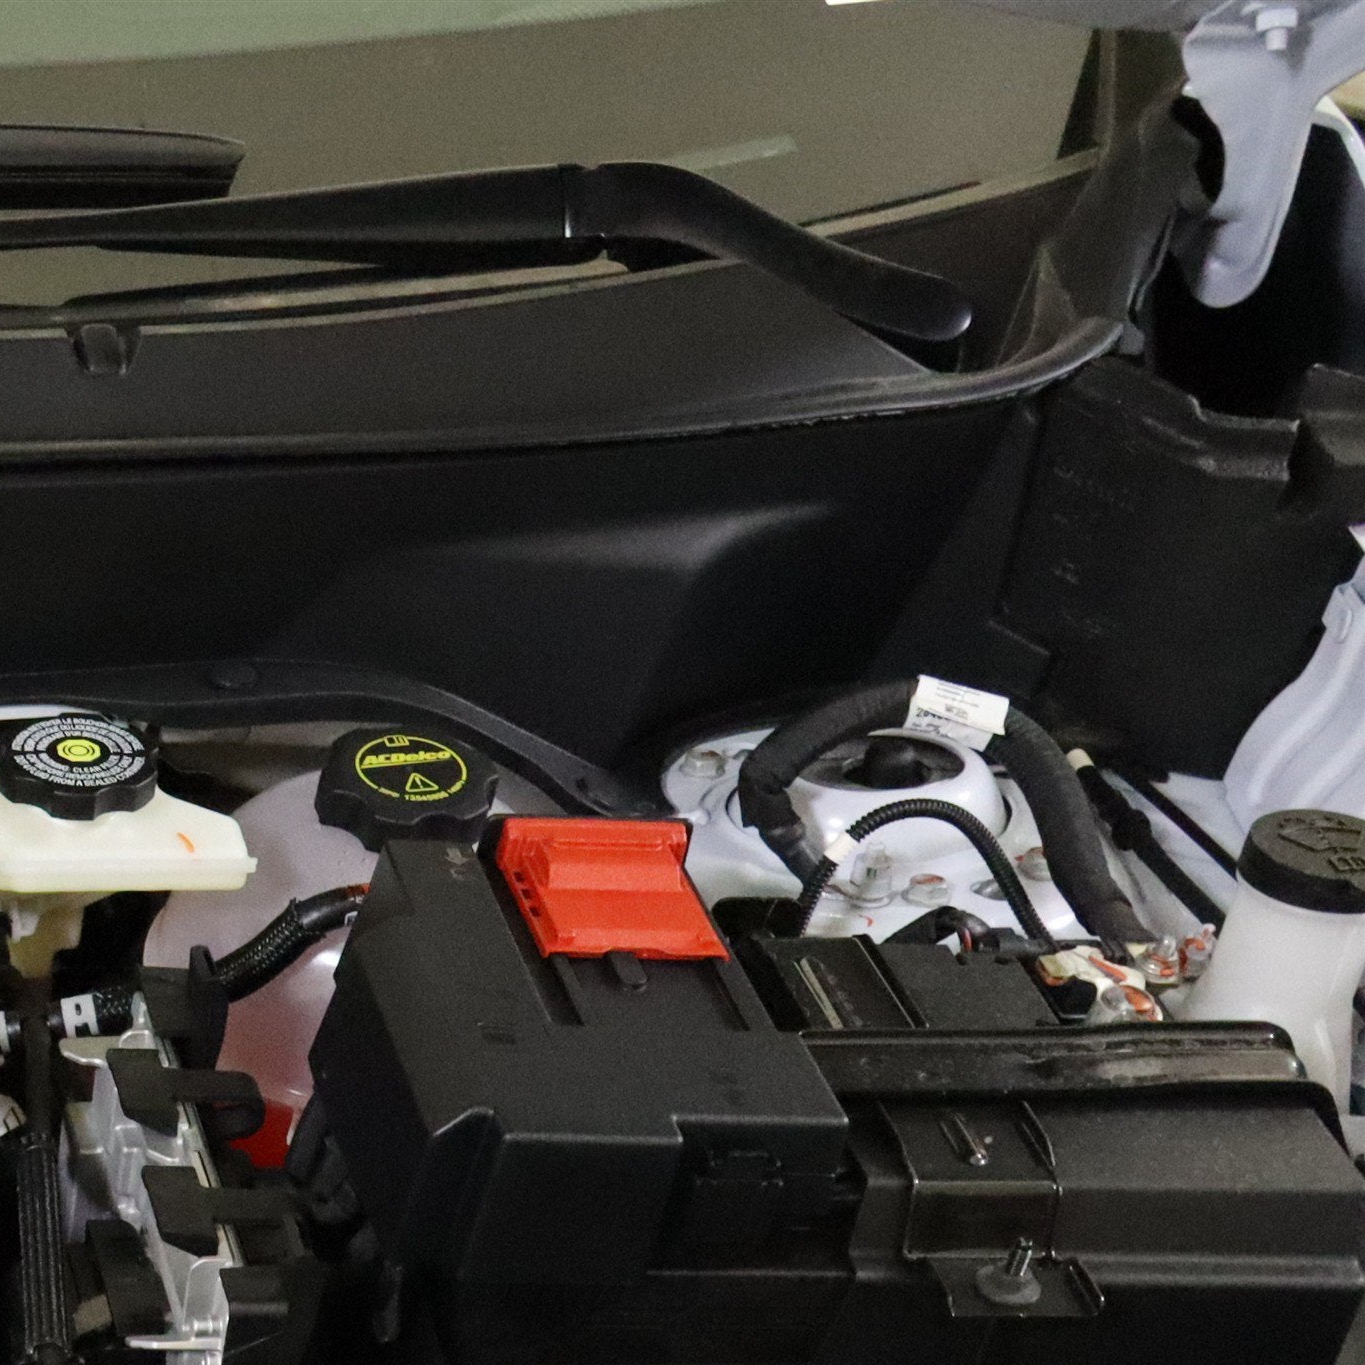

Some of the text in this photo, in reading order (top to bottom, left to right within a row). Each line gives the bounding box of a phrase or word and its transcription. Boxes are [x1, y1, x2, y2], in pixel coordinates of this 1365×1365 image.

[362, 751, 451, 766] ACDelco
[48, 775, 75, 786] FROM
[75, 779, 84, 787] A
